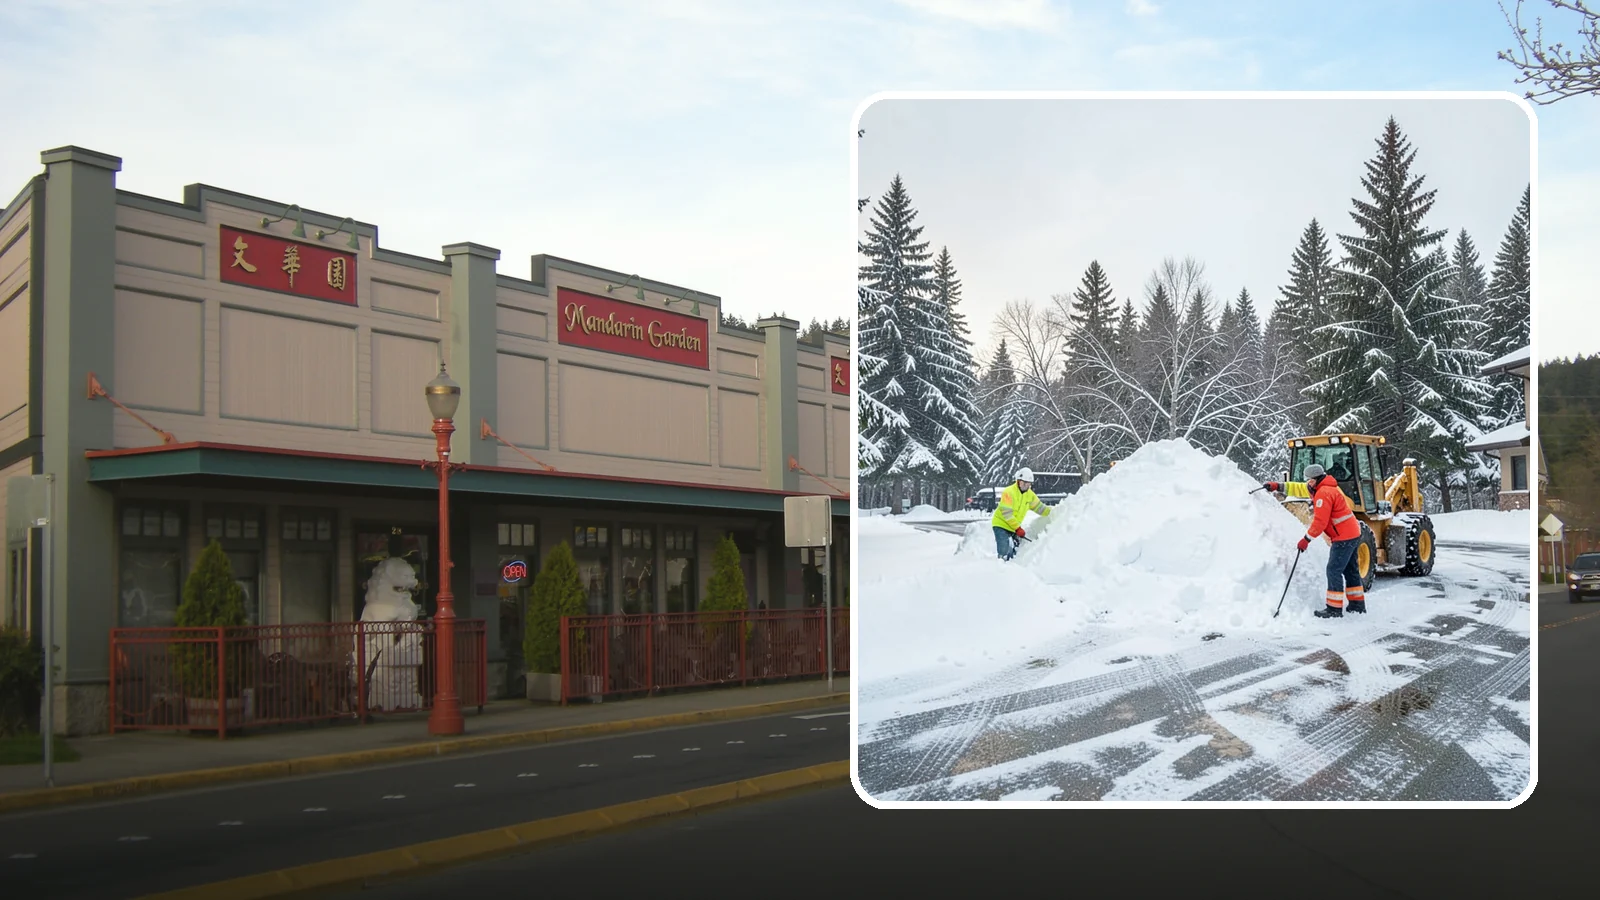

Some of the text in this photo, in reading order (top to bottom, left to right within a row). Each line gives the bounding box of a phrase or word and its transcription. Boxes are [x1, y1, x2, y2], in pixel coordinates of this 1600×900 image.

[231, 236, 346, 291] 文華園
[564, 302, 701, 352] Mandarin Garden
[835, 363, 846, 386] 文
[503, 565, 527, 578] OPEN
